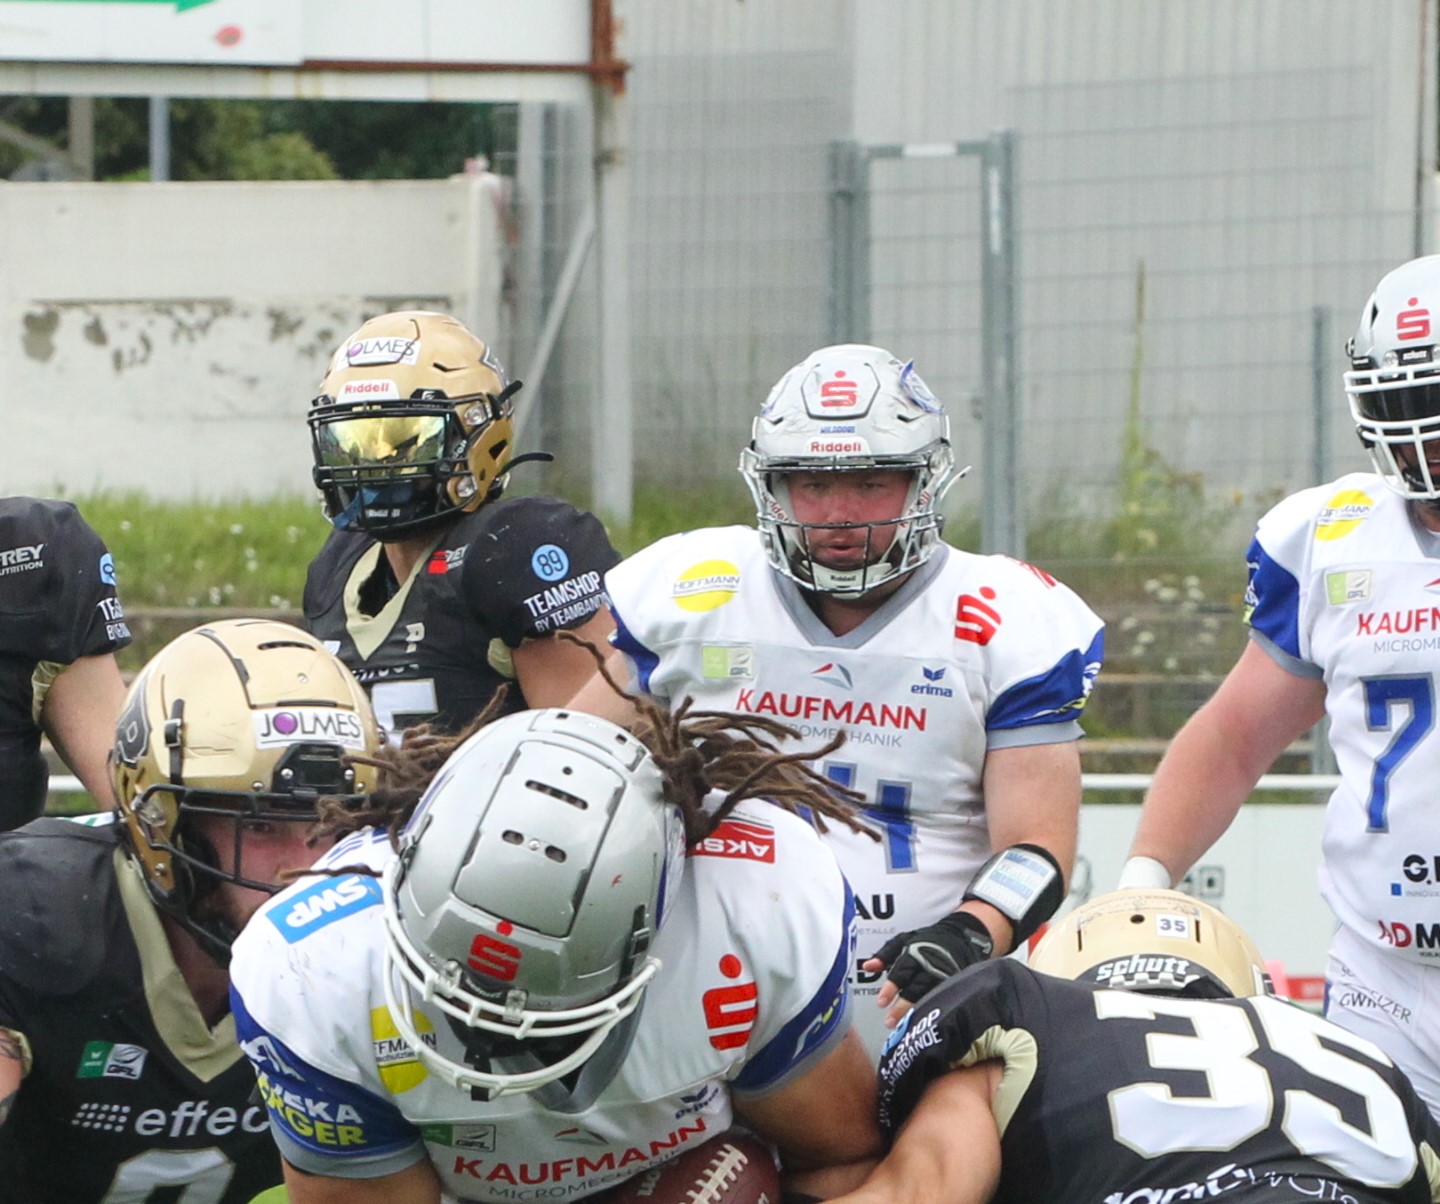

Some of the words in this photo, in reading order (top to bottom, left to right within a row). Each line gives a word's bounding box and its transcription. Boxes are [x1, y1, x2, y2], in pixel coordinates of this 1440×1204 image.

[345, 382, 389, 394] Riddell
[811, 441, 862, 453] Riddell
[537, 550, 565, 577] 89
[523, 571, 600, 617] TEAMSHOP
[673, 575, 740, 591] HOFFMANN
[535, 616, 550, 632] BY
[910, 682, 953, 698] erima
[736, 688, 927, 732] KAUFMANN
[261, 711, 361, 738] JOLMES
[286, 875, 369, 928] SWP
[1160, 918, 1186, 933] 35
[1092, 989, 1420, 1189] 35
[134, 1100, 270, 1138] effec
[453, 1117, 707, 1186] KAUFMANN
